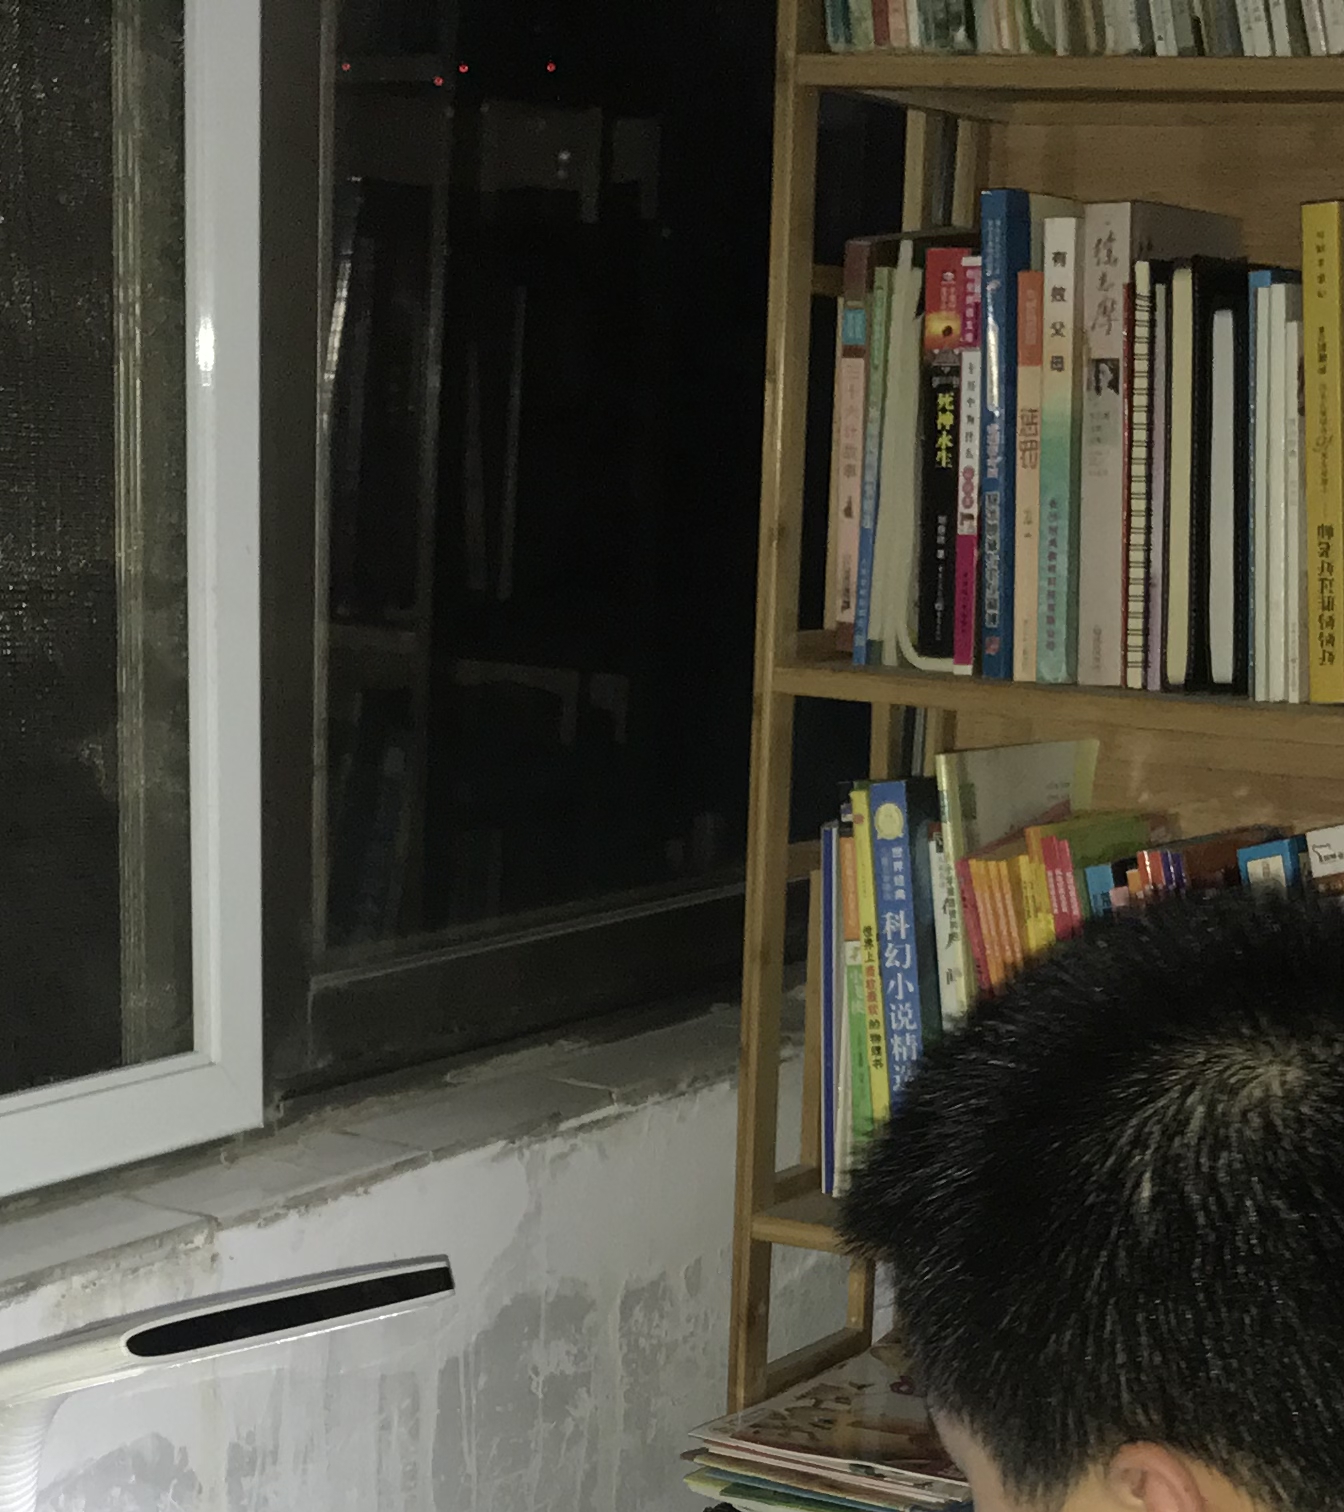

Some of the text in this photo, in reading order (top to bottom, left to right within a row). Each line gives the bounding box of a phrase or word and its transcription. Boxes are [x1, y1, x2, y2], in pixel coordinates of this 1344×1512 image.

[936, 392, 955, 469] 死神永生
[1316, 523, 1336, 667] 好妈妈胜过好老师
[892, 846, 907, 901] 世界经典
